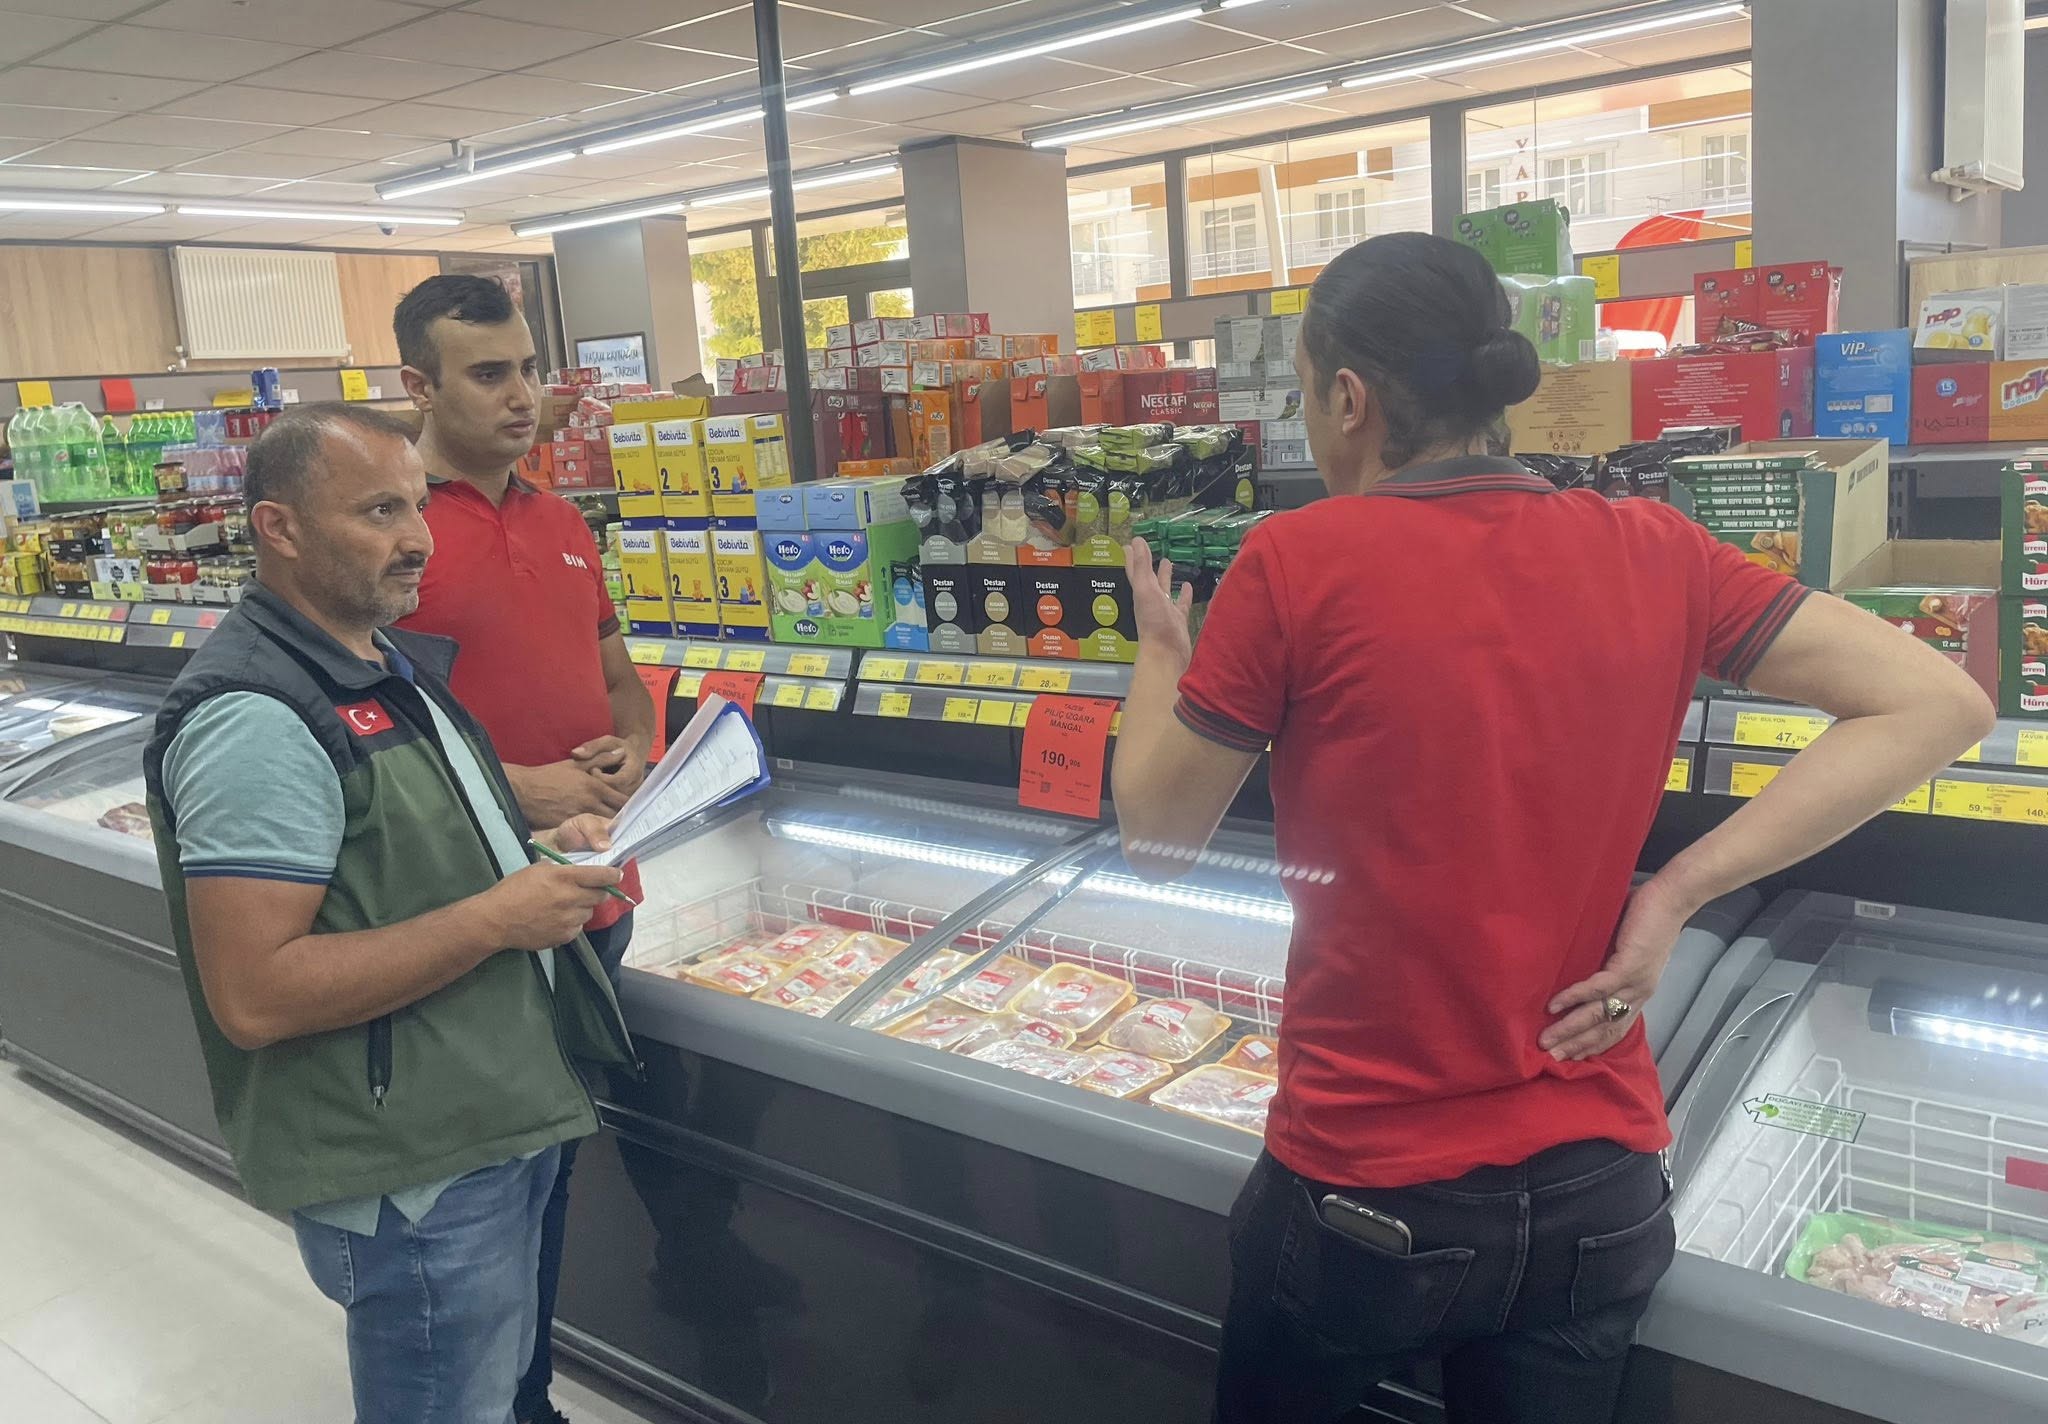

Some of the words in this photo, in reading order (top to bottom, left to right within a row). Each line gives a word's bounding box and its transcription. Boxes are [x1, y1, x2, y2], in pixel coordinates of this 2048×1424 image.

[1150, 408, 1183, 416] CLASSIC
[613, 431, 642, 444] Bebivita
[658, 430, 688, 442] Bebivita
[708, 426, 740, 439] Bebivita
[616, 469, 626, 491] 1
[660, 468, 670, 490] 2
[711, 466, 721, 489] 3
[1638, 471, 1668, 480] Destan
[622, 537, 650, 550] Bebivita
[670, 536, 700, 550] Bebivita
[718, 537, 749, 551] Bebivita
[778, 544, 800, 556] Hero
[829, 544, 852, 556] Hero
[627, 573, 635, 594] 1
[672, 573, 682, 595] 2
[719, 575, 730, 598] 3
[933, 578, 954, 587] Destan
[983, 578, 1006, 587] Destan
[1035, 581, 1059, 590] Destan
[1091, 580, 1116, 589] Destan
[796, 622, 817, 633] Hero
[1049, 719, 1084, 733] MANGAL
